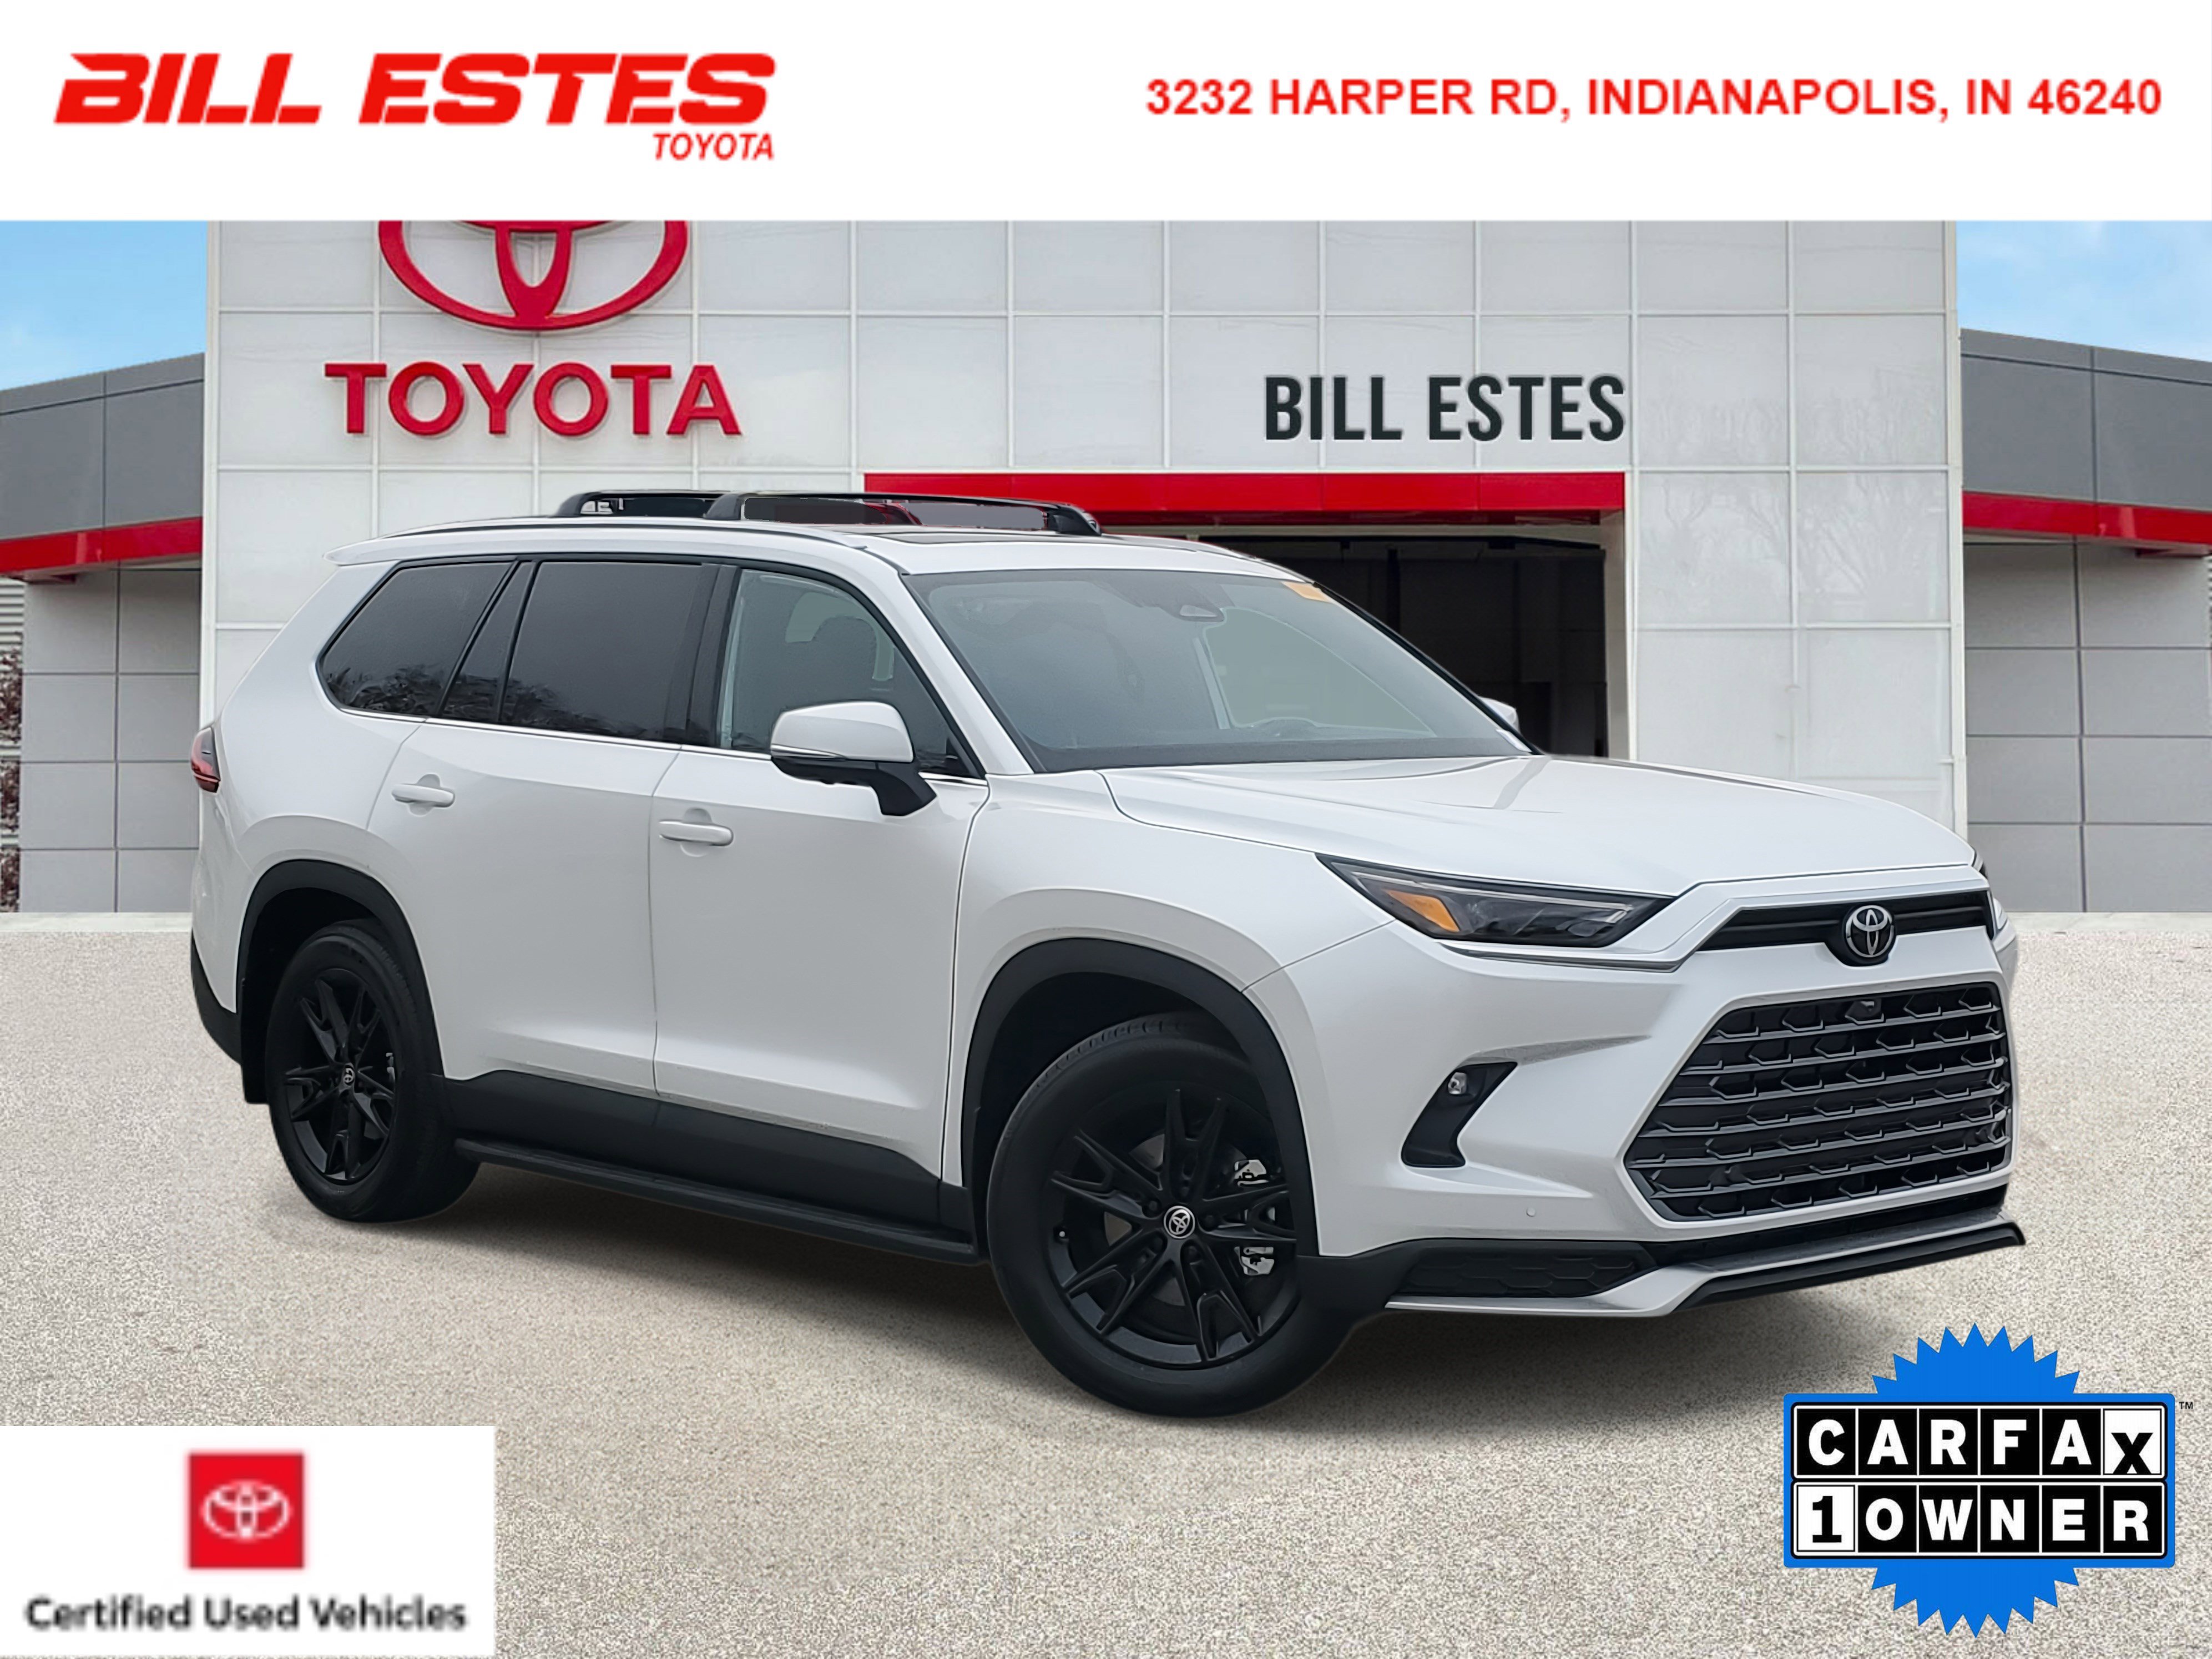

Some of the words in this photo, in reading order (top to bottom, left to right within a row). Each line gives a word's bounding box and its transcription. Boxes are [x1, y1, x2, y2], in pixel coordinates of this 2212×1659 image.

[325, 362, 741, 436] TOYOTA
[1265, 376, 1402, 440] BILL
[1428, 375, 1624, 441] ESTES
